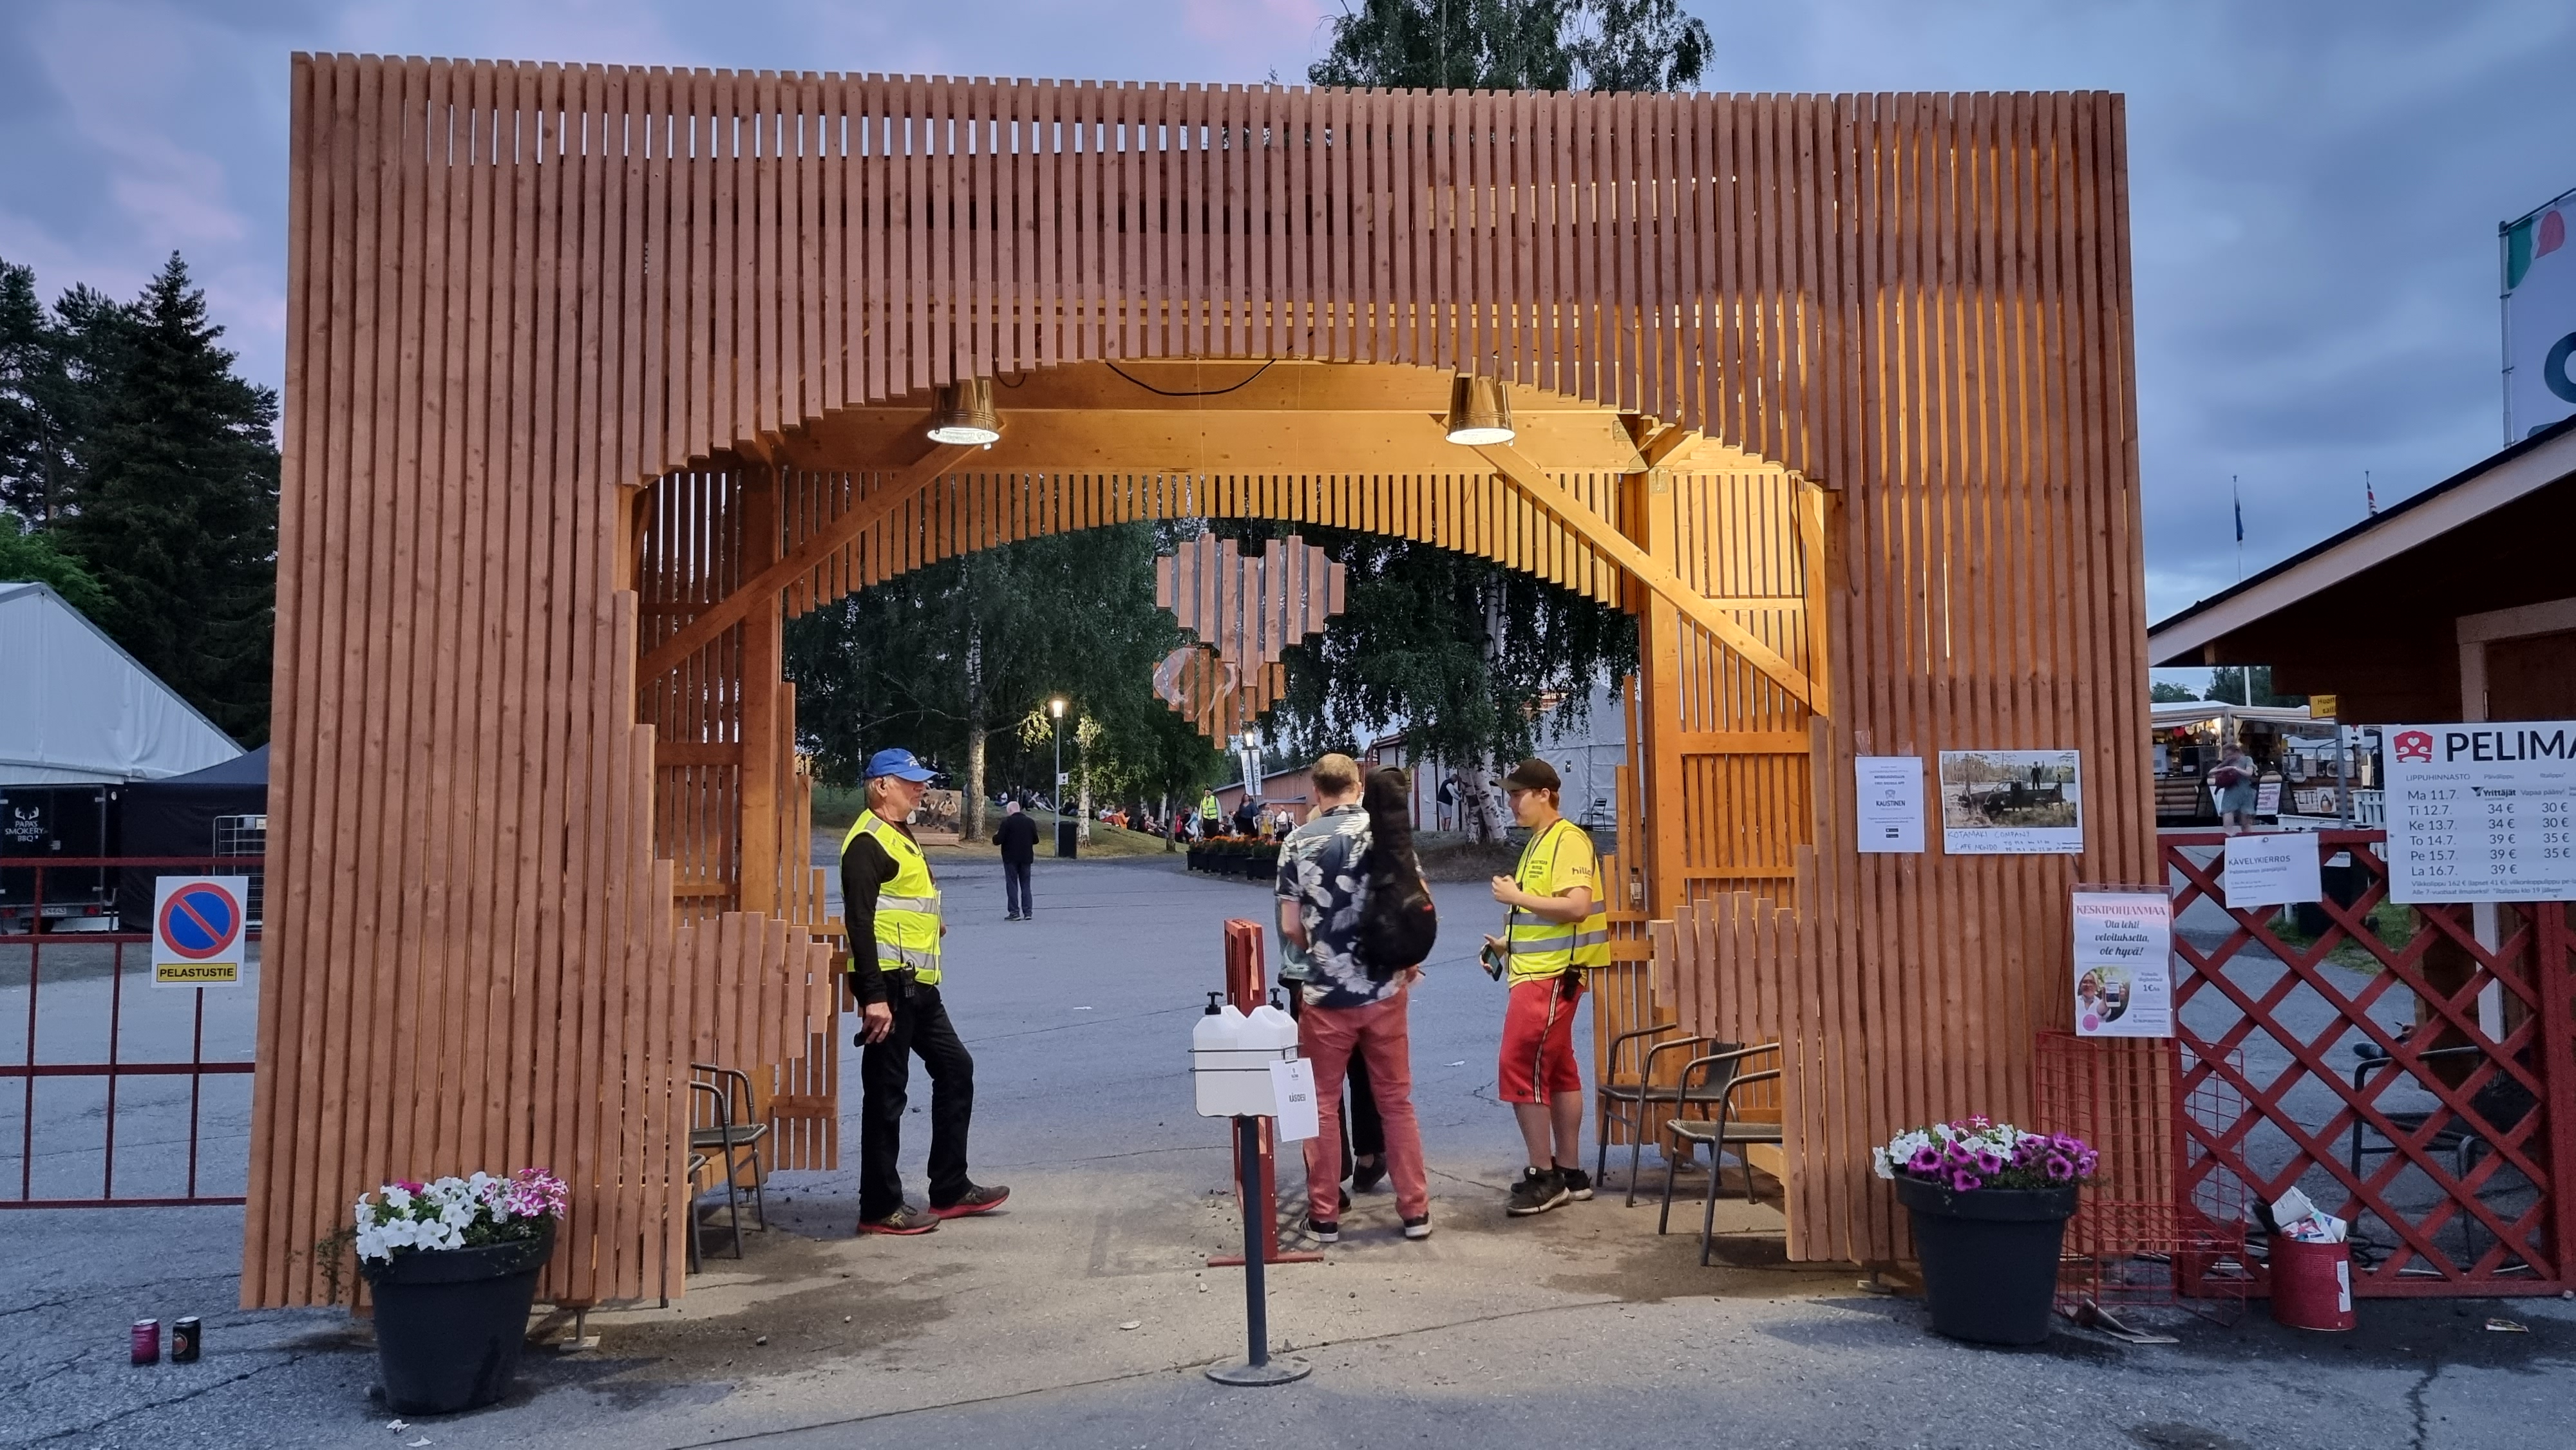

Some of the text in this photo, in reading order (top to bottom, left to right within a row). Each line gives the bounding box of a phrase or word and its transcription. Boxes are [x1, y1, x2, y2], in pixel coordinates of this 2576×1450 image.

[2406, 773, 2470, 782] LIPPUHINNASTO
[2408, 790, 2426, 800] Ma
[2430, 789, 2459, 800] 11.7.
[2483, 789, 2516, 798] Yrittäjät
[2408, 802, 2568, 815] Ti 12.7. 34 € 30 €
[2409, 818, 2569, 831] Ke 13.7. 34 € 30 €
[2409, 833, 2570, 845] To 14.7. 39 € 35 €
[2228, 855, 2291, 865] KÄVELYKIERROS
[2410, 848, 2571, 861] Pe 15.7. 39 € 35 €
[2412, 865, 2517, 876] La 16.7. 39 €
[2076, 905, 2166, 916] KESKIPOHJANMAA
[2104, 919, 2120, 928] Ota
[2099, 946, 2144, 958] ole hyvä!
[160, 968, 234, 977] PELASTUSTIE
[1289, 1092, 1306, 1102] KÄSIDESI
